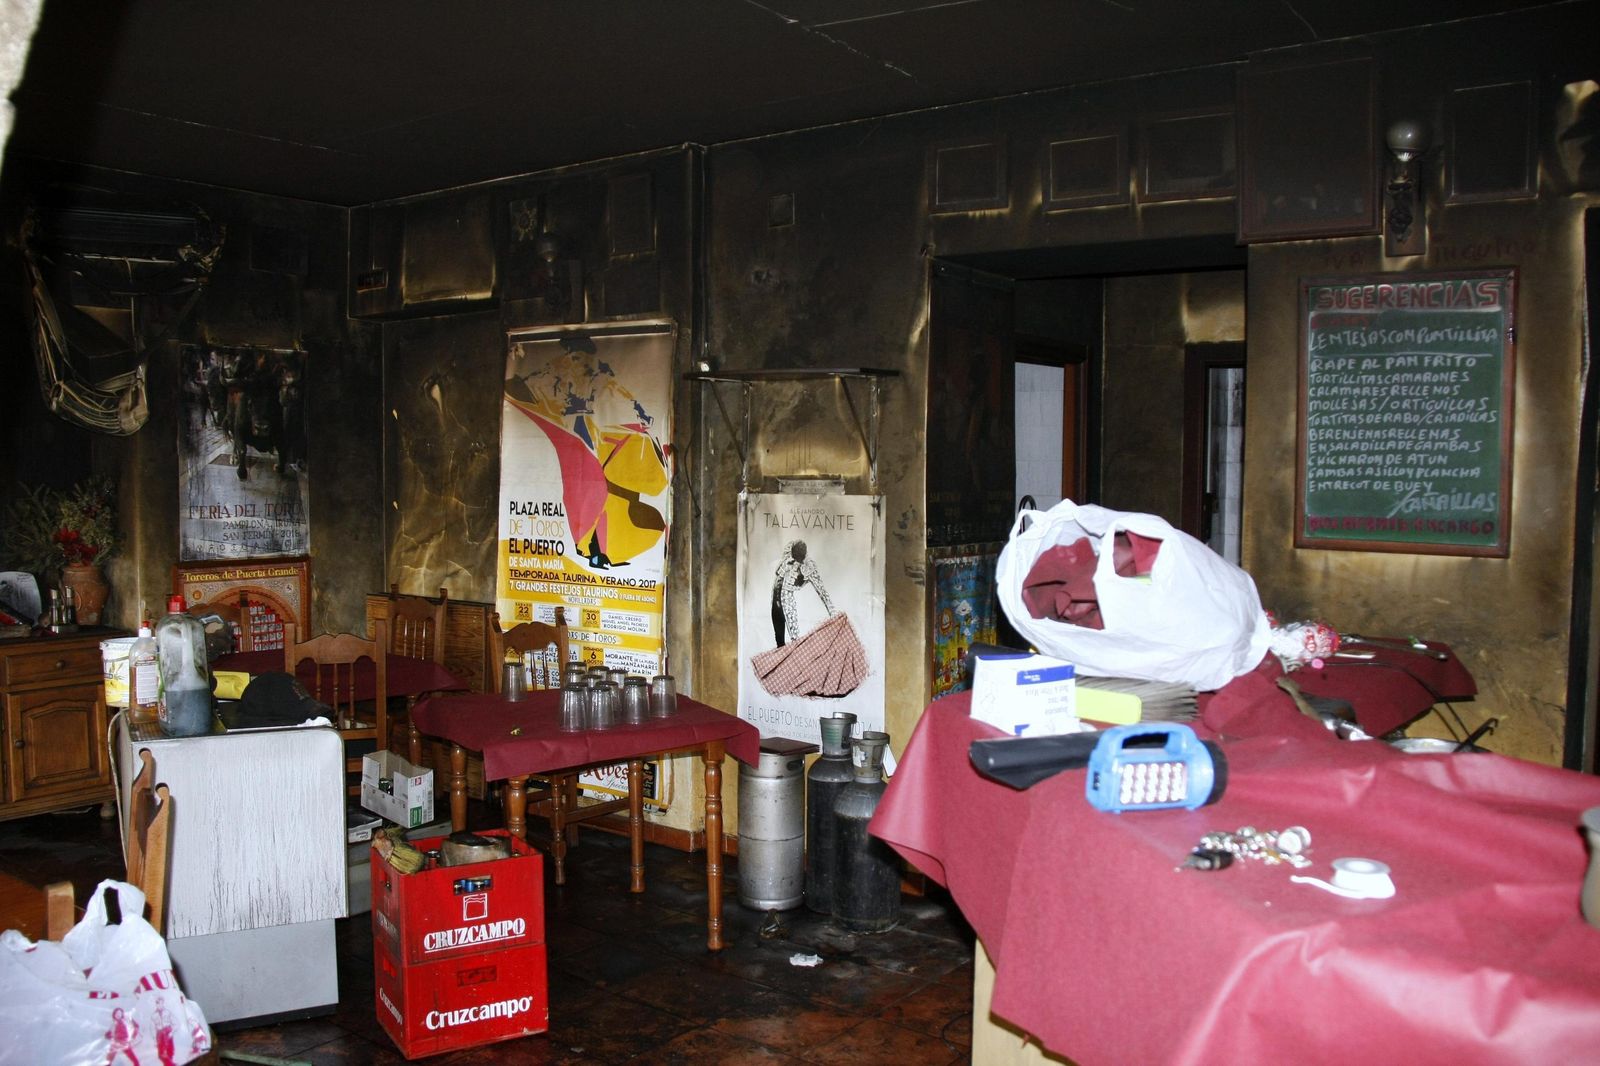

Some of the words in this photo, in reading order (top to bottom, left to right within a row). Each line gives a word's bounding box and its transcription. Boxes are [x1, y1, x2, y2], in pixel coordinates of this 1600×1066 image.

[1317, 281, 1503, 309] SUGERENCIAS
[1311, 358, 1357, 371] RAPE
[1361, 359, 1381, 370] AL
[1386, 356, 1418, 369] PAN
[1424, 355, 1476, 367] FRITO
[1390, 385, 1461, 396] RELLENOS
[1407, 453, 1448, 465] ATUN
[1416, 467, 1481, 479] PLANCHA
[1373, 481, 1391, 490] DE
[1394, 481, 1434, 493] BUEY
[235, 504, 261, 517] DEL
[509, 501, 540, 516] PLAZA
[542, 502, 564, 517] REAL
[509, 519, 523, 536] DE
[528, 516, 565, 538] TOROS
[763, 512, 855, 531] TALAVANTE
[223, 532, 240, 541] SAN
[509, 538, 520, 554] EL
[523, 539, 565, 556] PUERTO
[509, 557, 517, 566] DE
[519, 558, 541, 568] SANTA
[184, 571, 219, 582] Toreros
[222, 570, 233, 579] de
[236, 568, 265, 579] Puerta
[268, 566, 299, 577] Grande
[509, 569, 560, 581] TEMPORADA
[563, 573, 597, 584] TAURINA
[600, 576, 636, 587] VERANO
[638, 579, 657, 588] 2017
[509, 580, 514, 590] 7
[515, 581, 548, 592] GRANDES
[549, 583, 581, 594] FESTEJOS
[582, 586, 619, 599] TAURINOS
[568, 596, 597, 605] NOVILLADAS
[518, 606, 529, 614] 22
[586, 612, 597, 621] 30
[581, 633, 589, 641] DE
[593, 632, 617, 644] TOROS
[590, 651, 597, 660] 6
[605, 653, 633, 662] MORANTE
[621, 661, 658, 671] MANZANARES
[747, 706, 757, 721] EL
[759, 707, 792, 726] PUERTO
[795, 715, 803, 727] DE
[423, 918, 526, 951] CRUZCAMPO
[425, 996, 532, 1031] Cruzcampo
